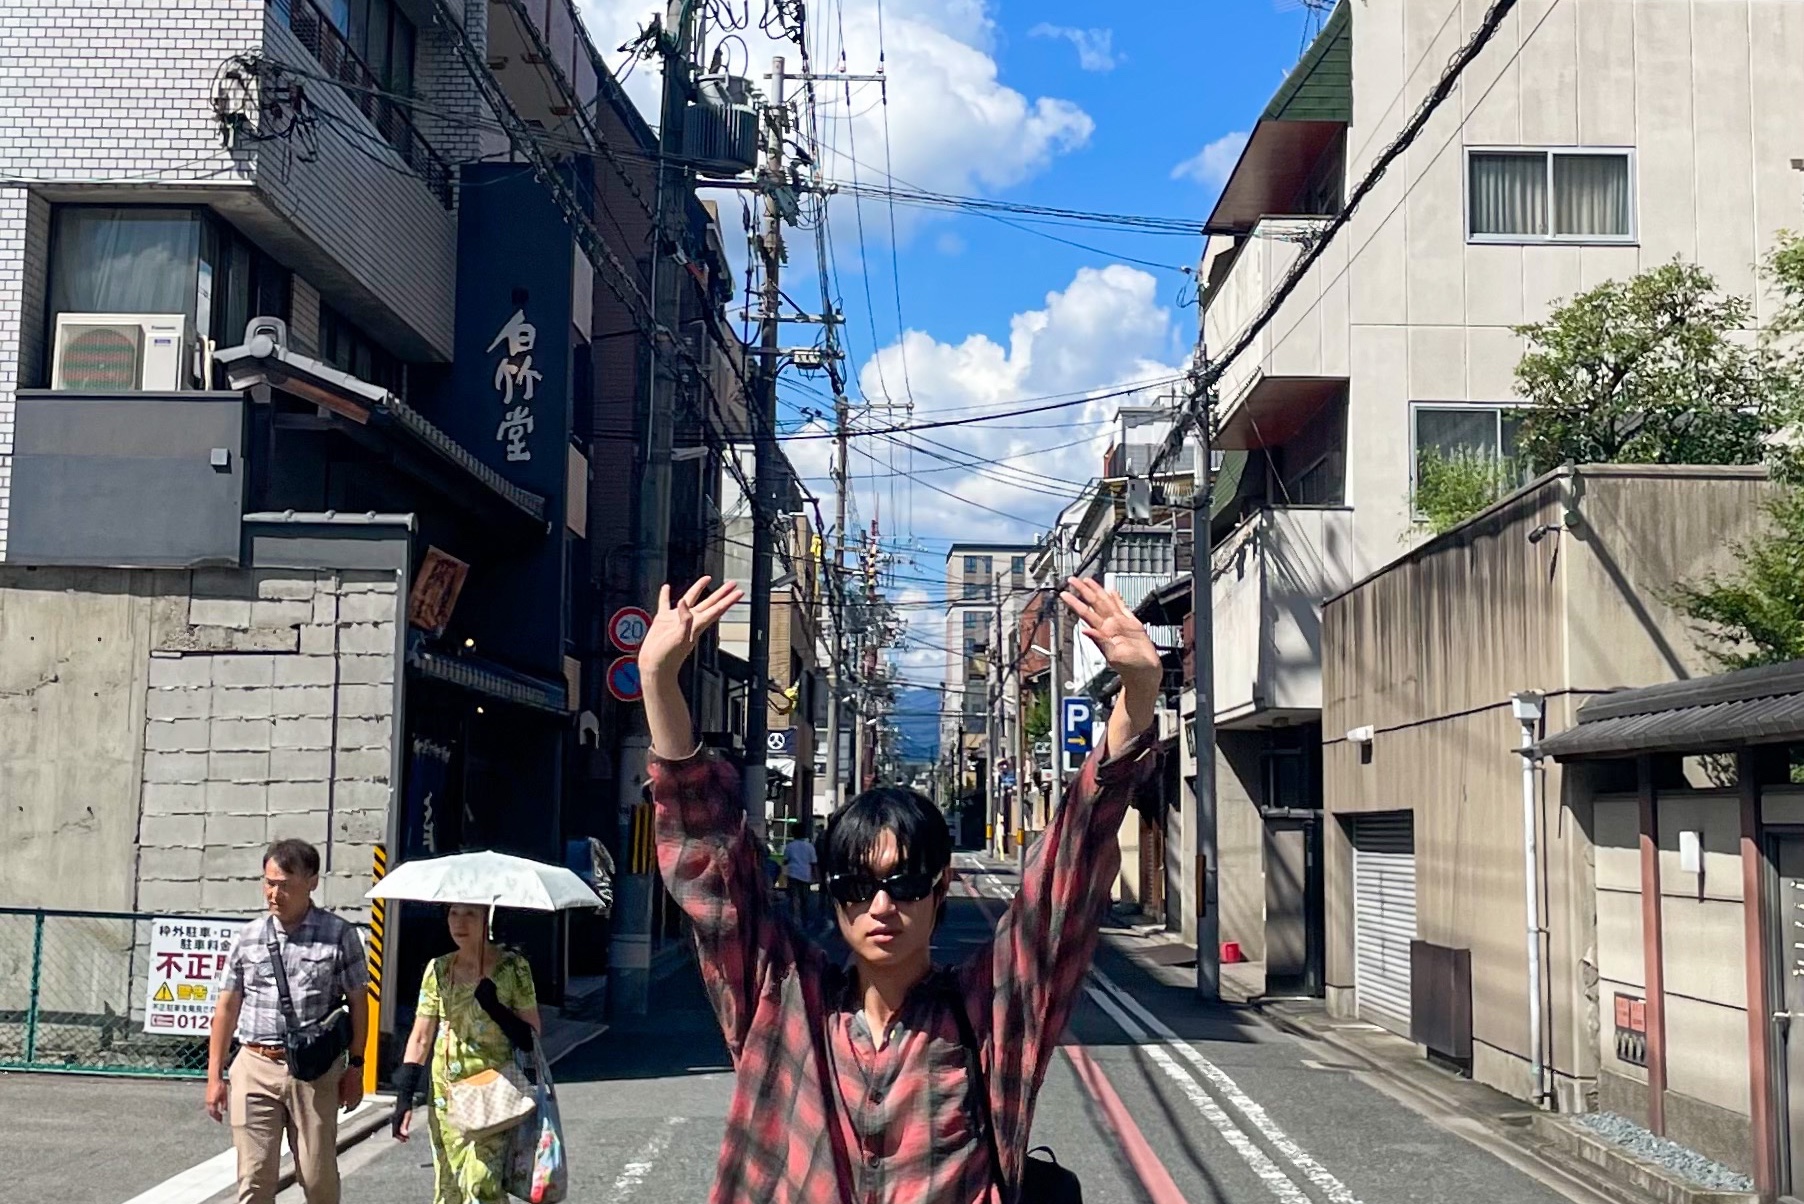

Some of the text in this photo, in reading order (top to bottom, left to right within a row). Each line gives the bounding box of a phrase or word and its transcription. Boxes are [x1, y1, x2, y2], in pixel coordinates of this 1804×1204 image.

[486, 309, 543, 461] 白竹堂
[619, 620, 644, 639] 20
[1068, 704, 1090, 731] P
[177, 1014, 214, 1029] 012
